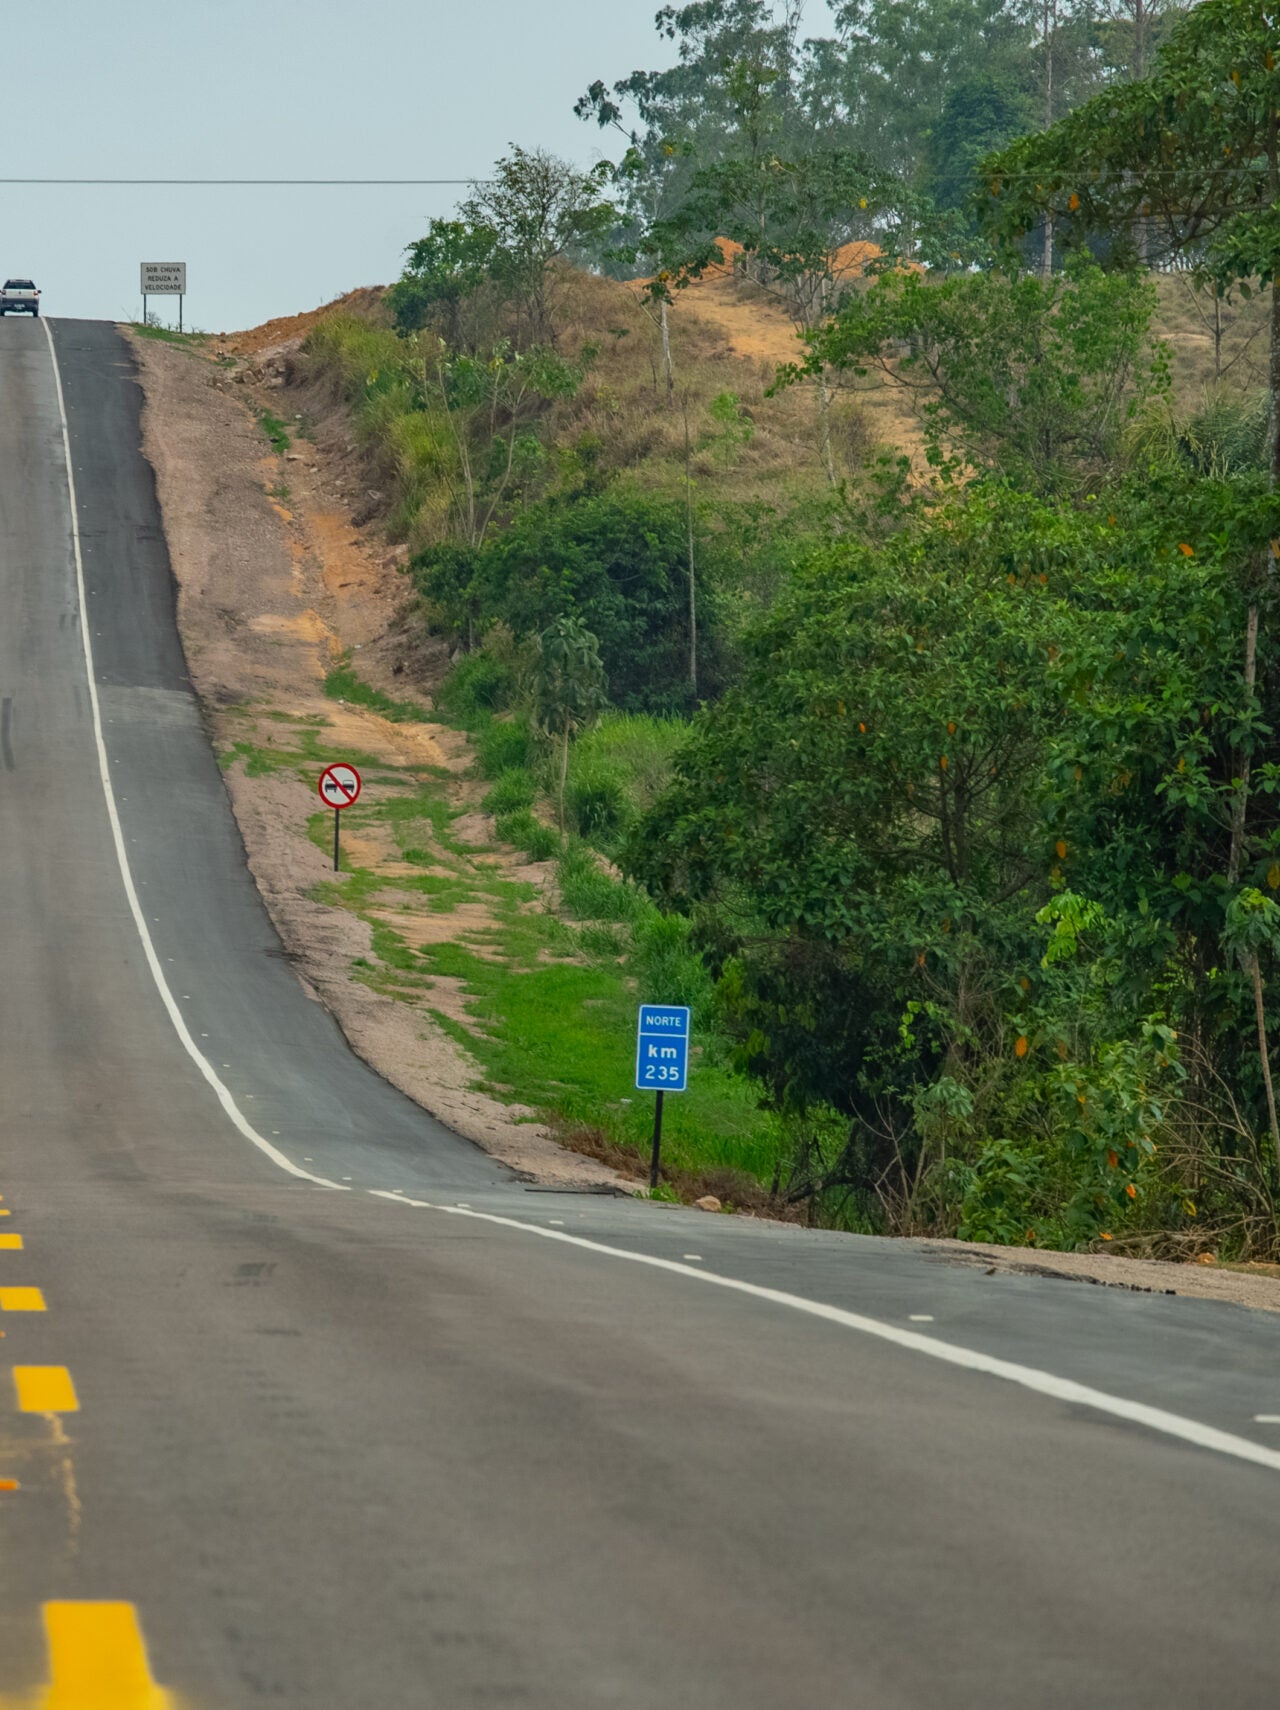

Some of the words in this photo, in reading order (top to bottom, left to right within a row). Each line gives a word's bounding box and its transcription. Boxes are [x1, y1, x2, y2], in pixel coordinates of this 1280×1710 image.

[646, 1016, 682, 1027] NORTE
[648, 1044, 677, 1058] km
[645, 1065, 680, 1080] 235
